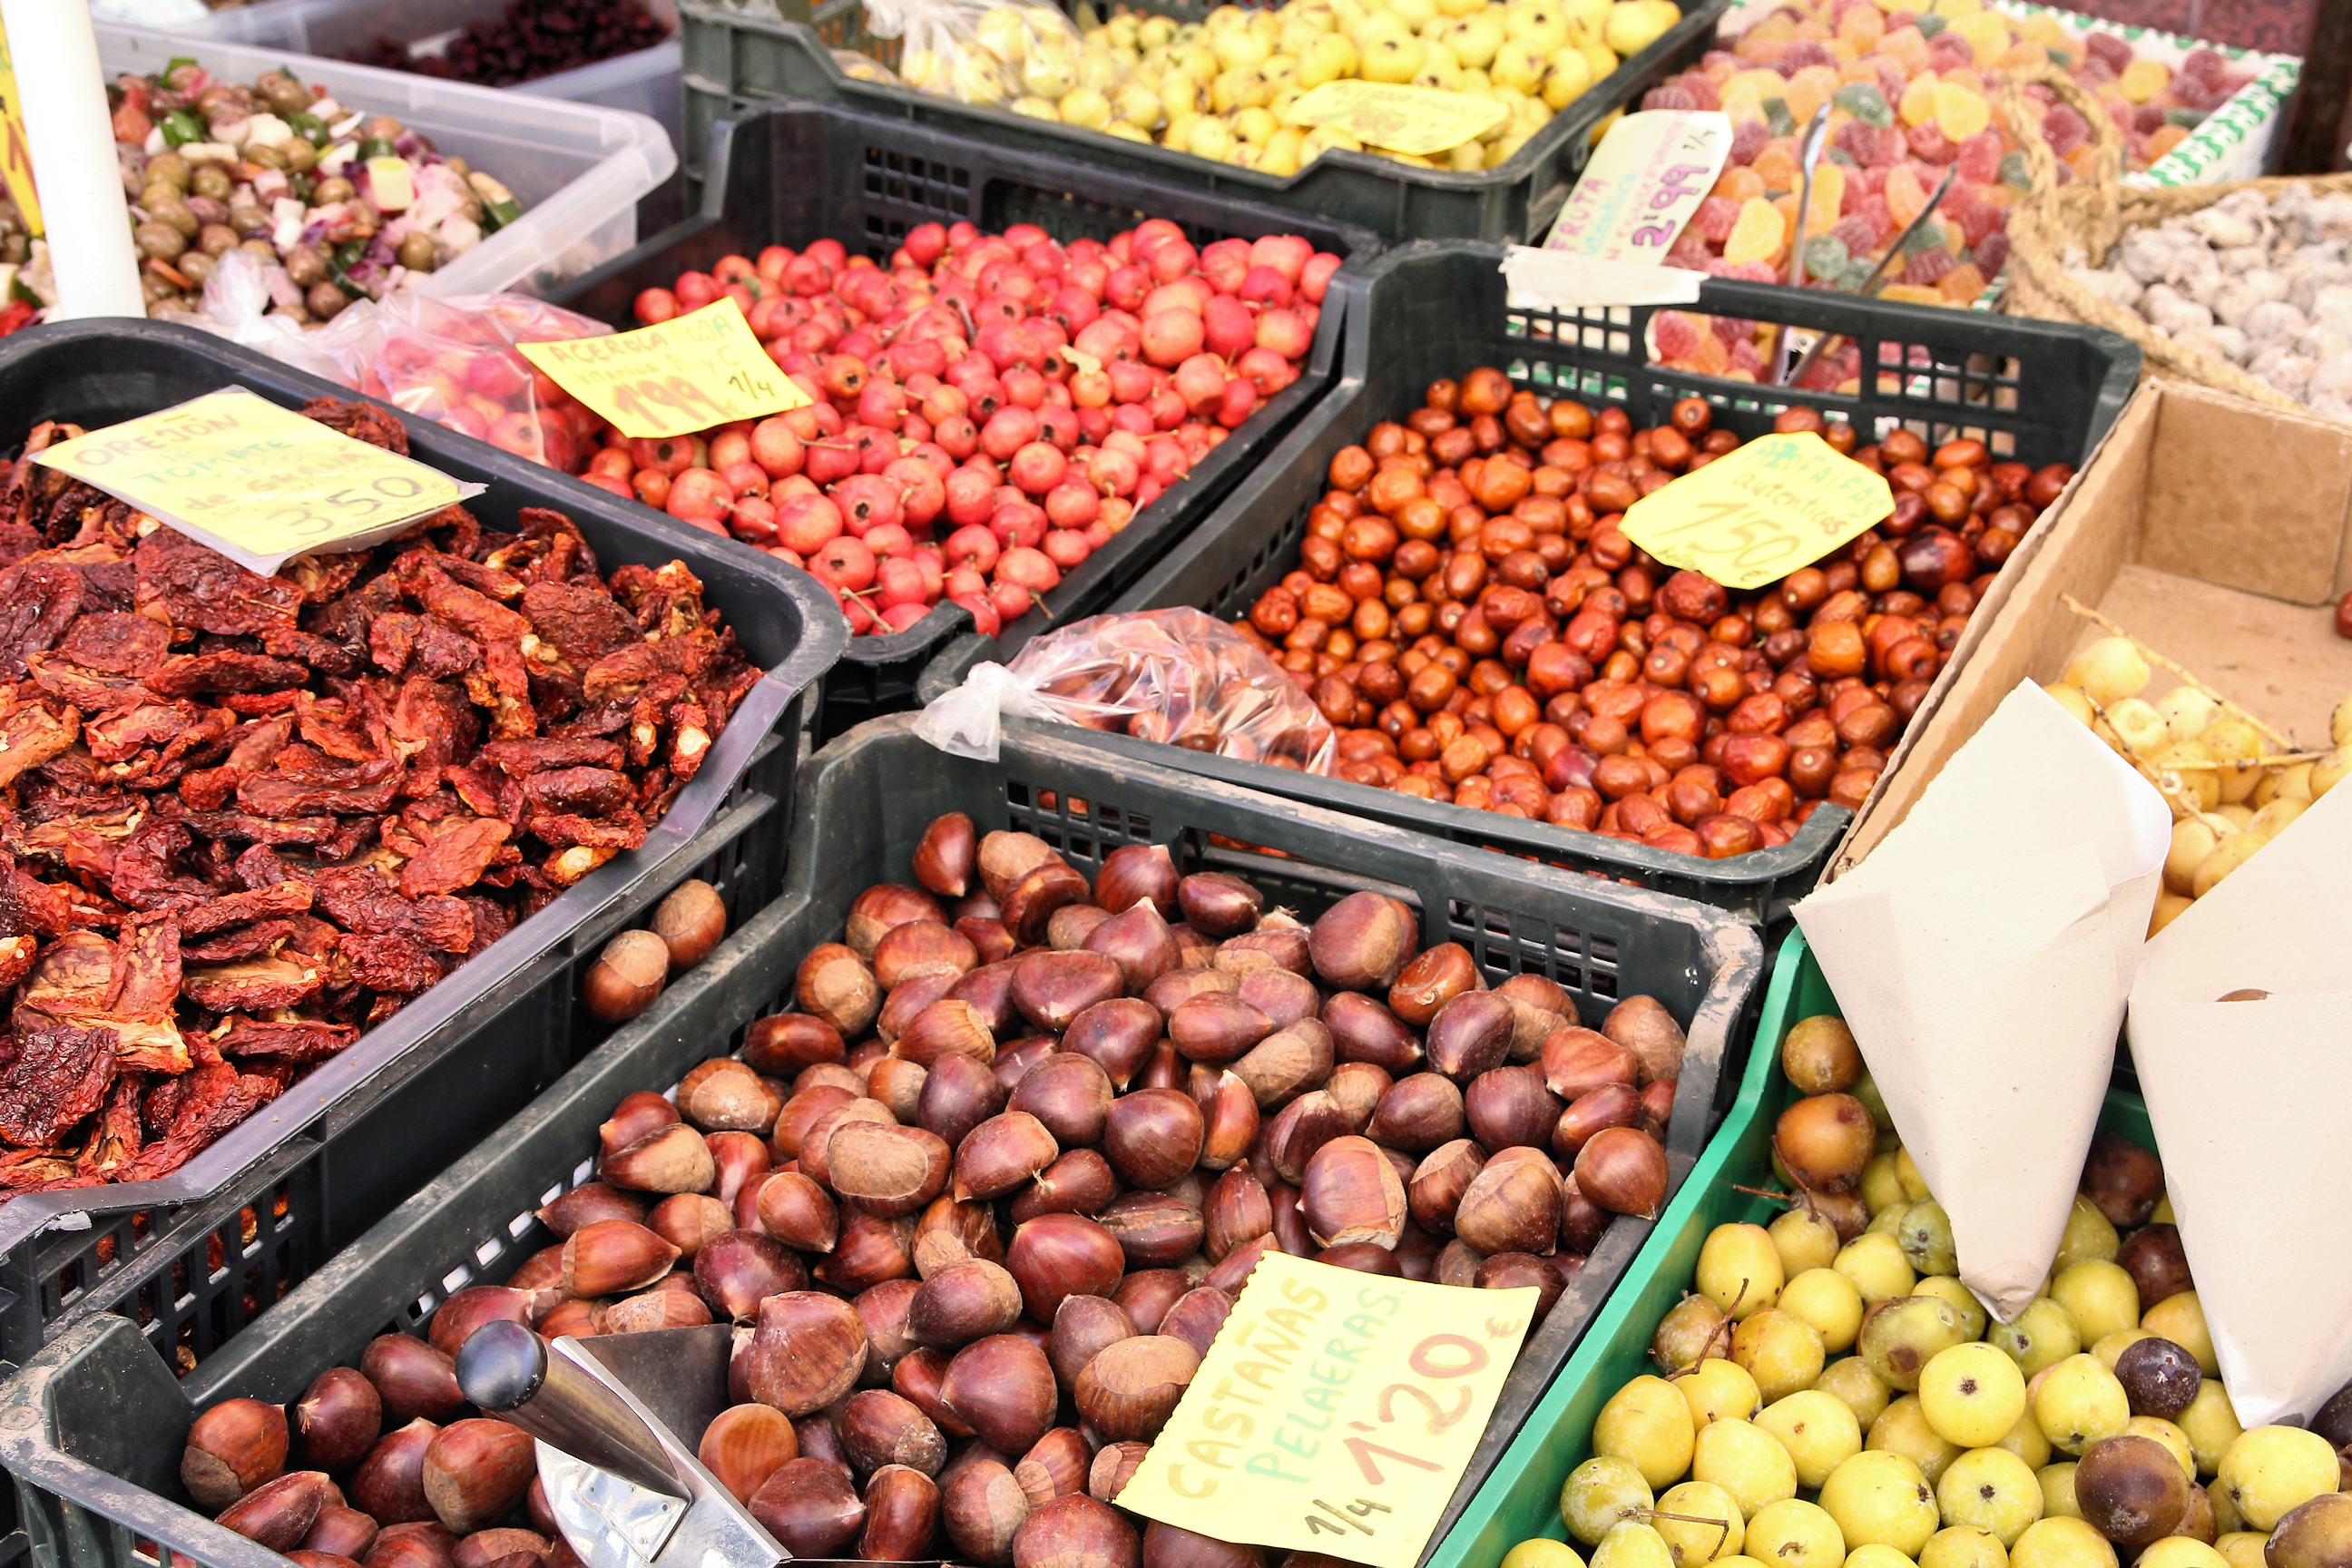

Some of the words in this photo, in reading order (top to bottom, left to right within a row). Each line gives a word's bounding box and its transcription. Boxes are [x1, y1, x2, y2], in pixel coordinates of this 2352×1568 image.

[1549, 178, 1610, 251] FRUTA
[1632, 164, 1710, 247] 2'99
[547, 332, 669, 364] ACEROLA
[719, 347, 739, 367] C
[612, 376, 734, 431] 1'99
[729, 371, 776, 400] 1/4
[133, 437, 294, 485] TOMATE
[184, 490, 232, 513] de
[266, 476, 422, 536] 3'50
[1651, 502, 1801, 568] 1'50
[1167, 1277, 1328, 1500] CASTAÑAS
[1244, 1288, 1401, 1485] PELAERAS
[1343, 1333, 1491, 1485] 1'20
[1304, 1499, 1393, 1537] 1/4
